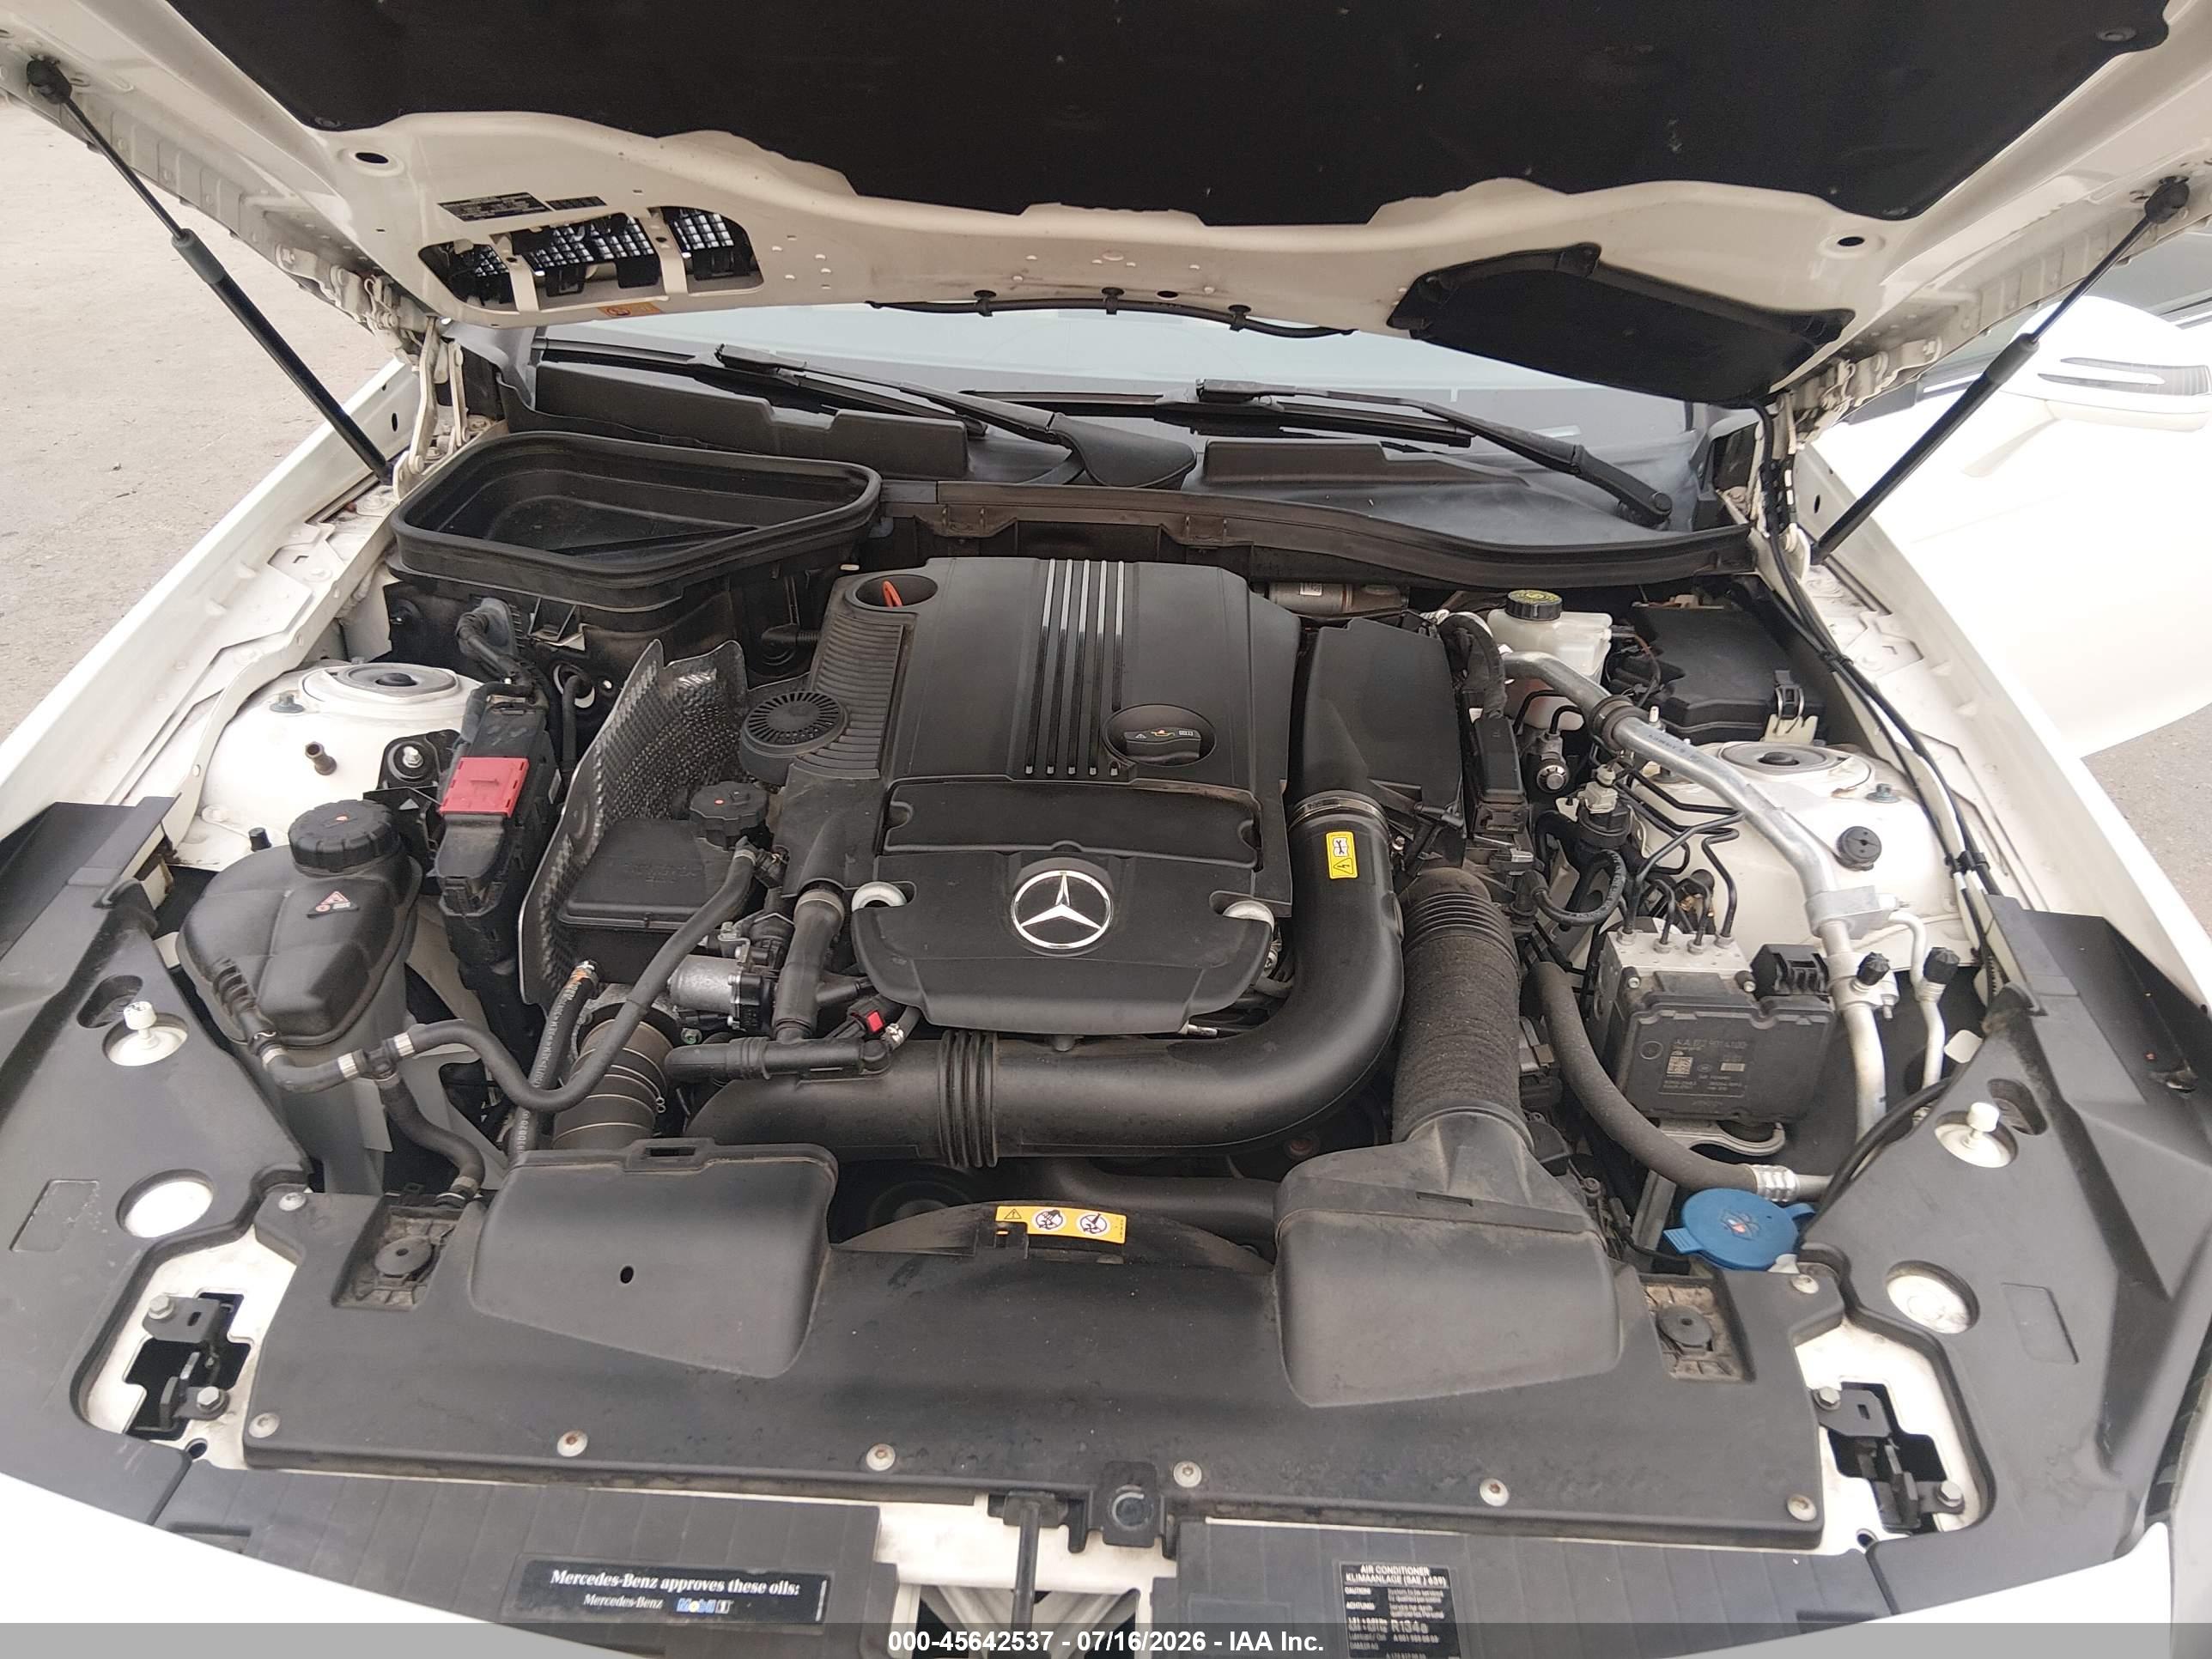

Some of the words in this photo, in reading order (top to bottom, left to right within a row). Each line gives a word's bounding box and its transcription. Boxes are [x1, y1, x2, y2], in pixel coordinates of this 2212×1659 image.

[1346, 1573, 1402, 1583] KLIMAANLAGE
[1360, 1565, 1374, 1574] AIR
[1376, 1565, 1430, 1577] CONDITIONER
[550, 1569, 659, 1589] Mercedes-Benz
[659, 1577, 725, 1593] approves
[727, 1578, 768, 1595] these
[769, 1580, 801, 1596] oils:
[583, 1593, 664, 1610] Mercedes-Benz
[1391, 1619, 1429, 1634] R134a
